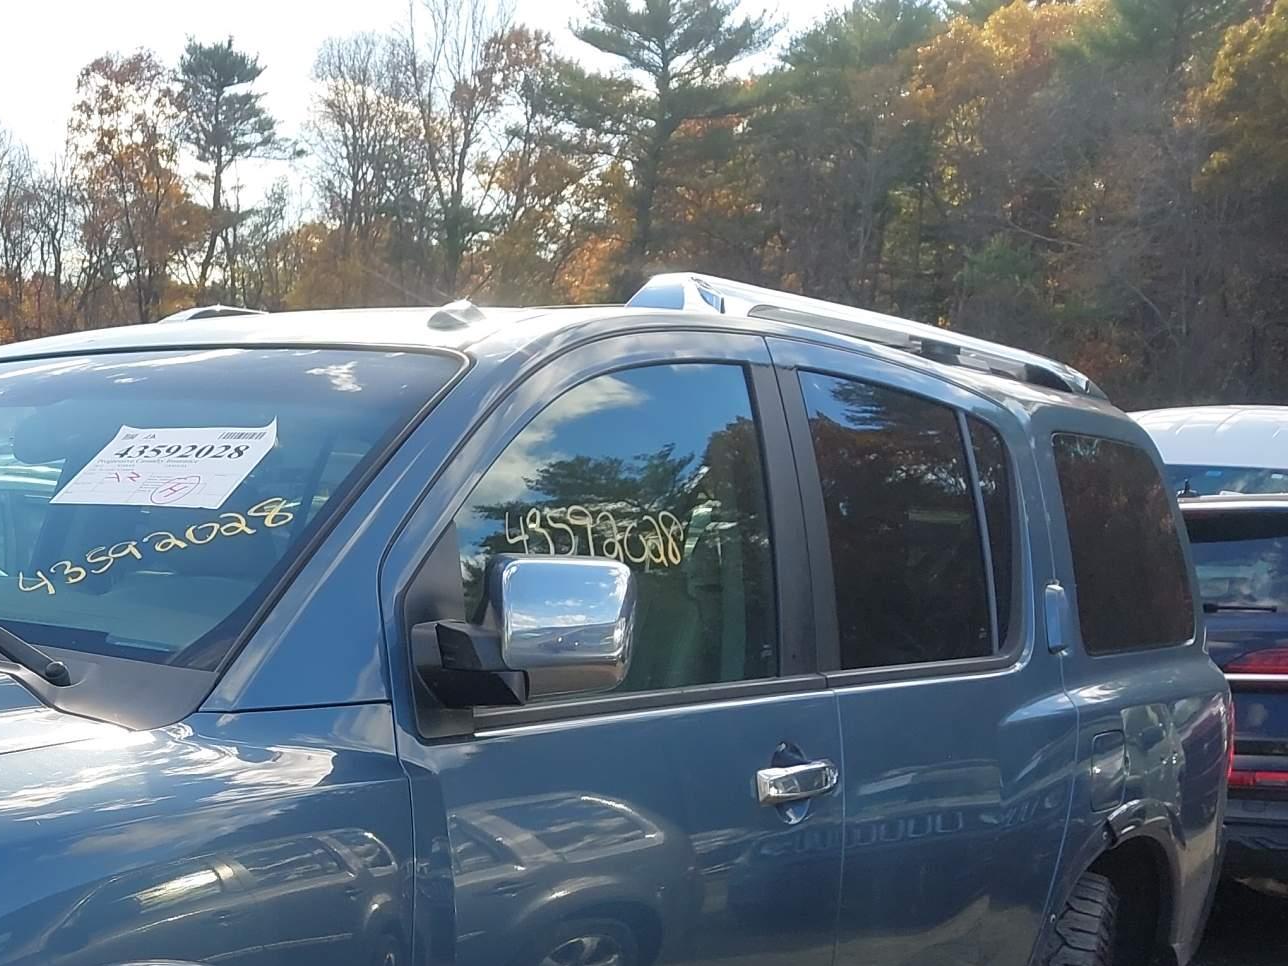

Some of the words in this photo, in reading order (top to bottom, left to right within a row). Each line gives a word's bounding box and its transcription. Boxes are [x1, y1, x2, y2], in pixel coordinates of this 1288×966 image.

[114, 444, 250, 459] 43592028
[17, 497, 294, 595] 43592028
[505, 506, 685, 567] 43592028
